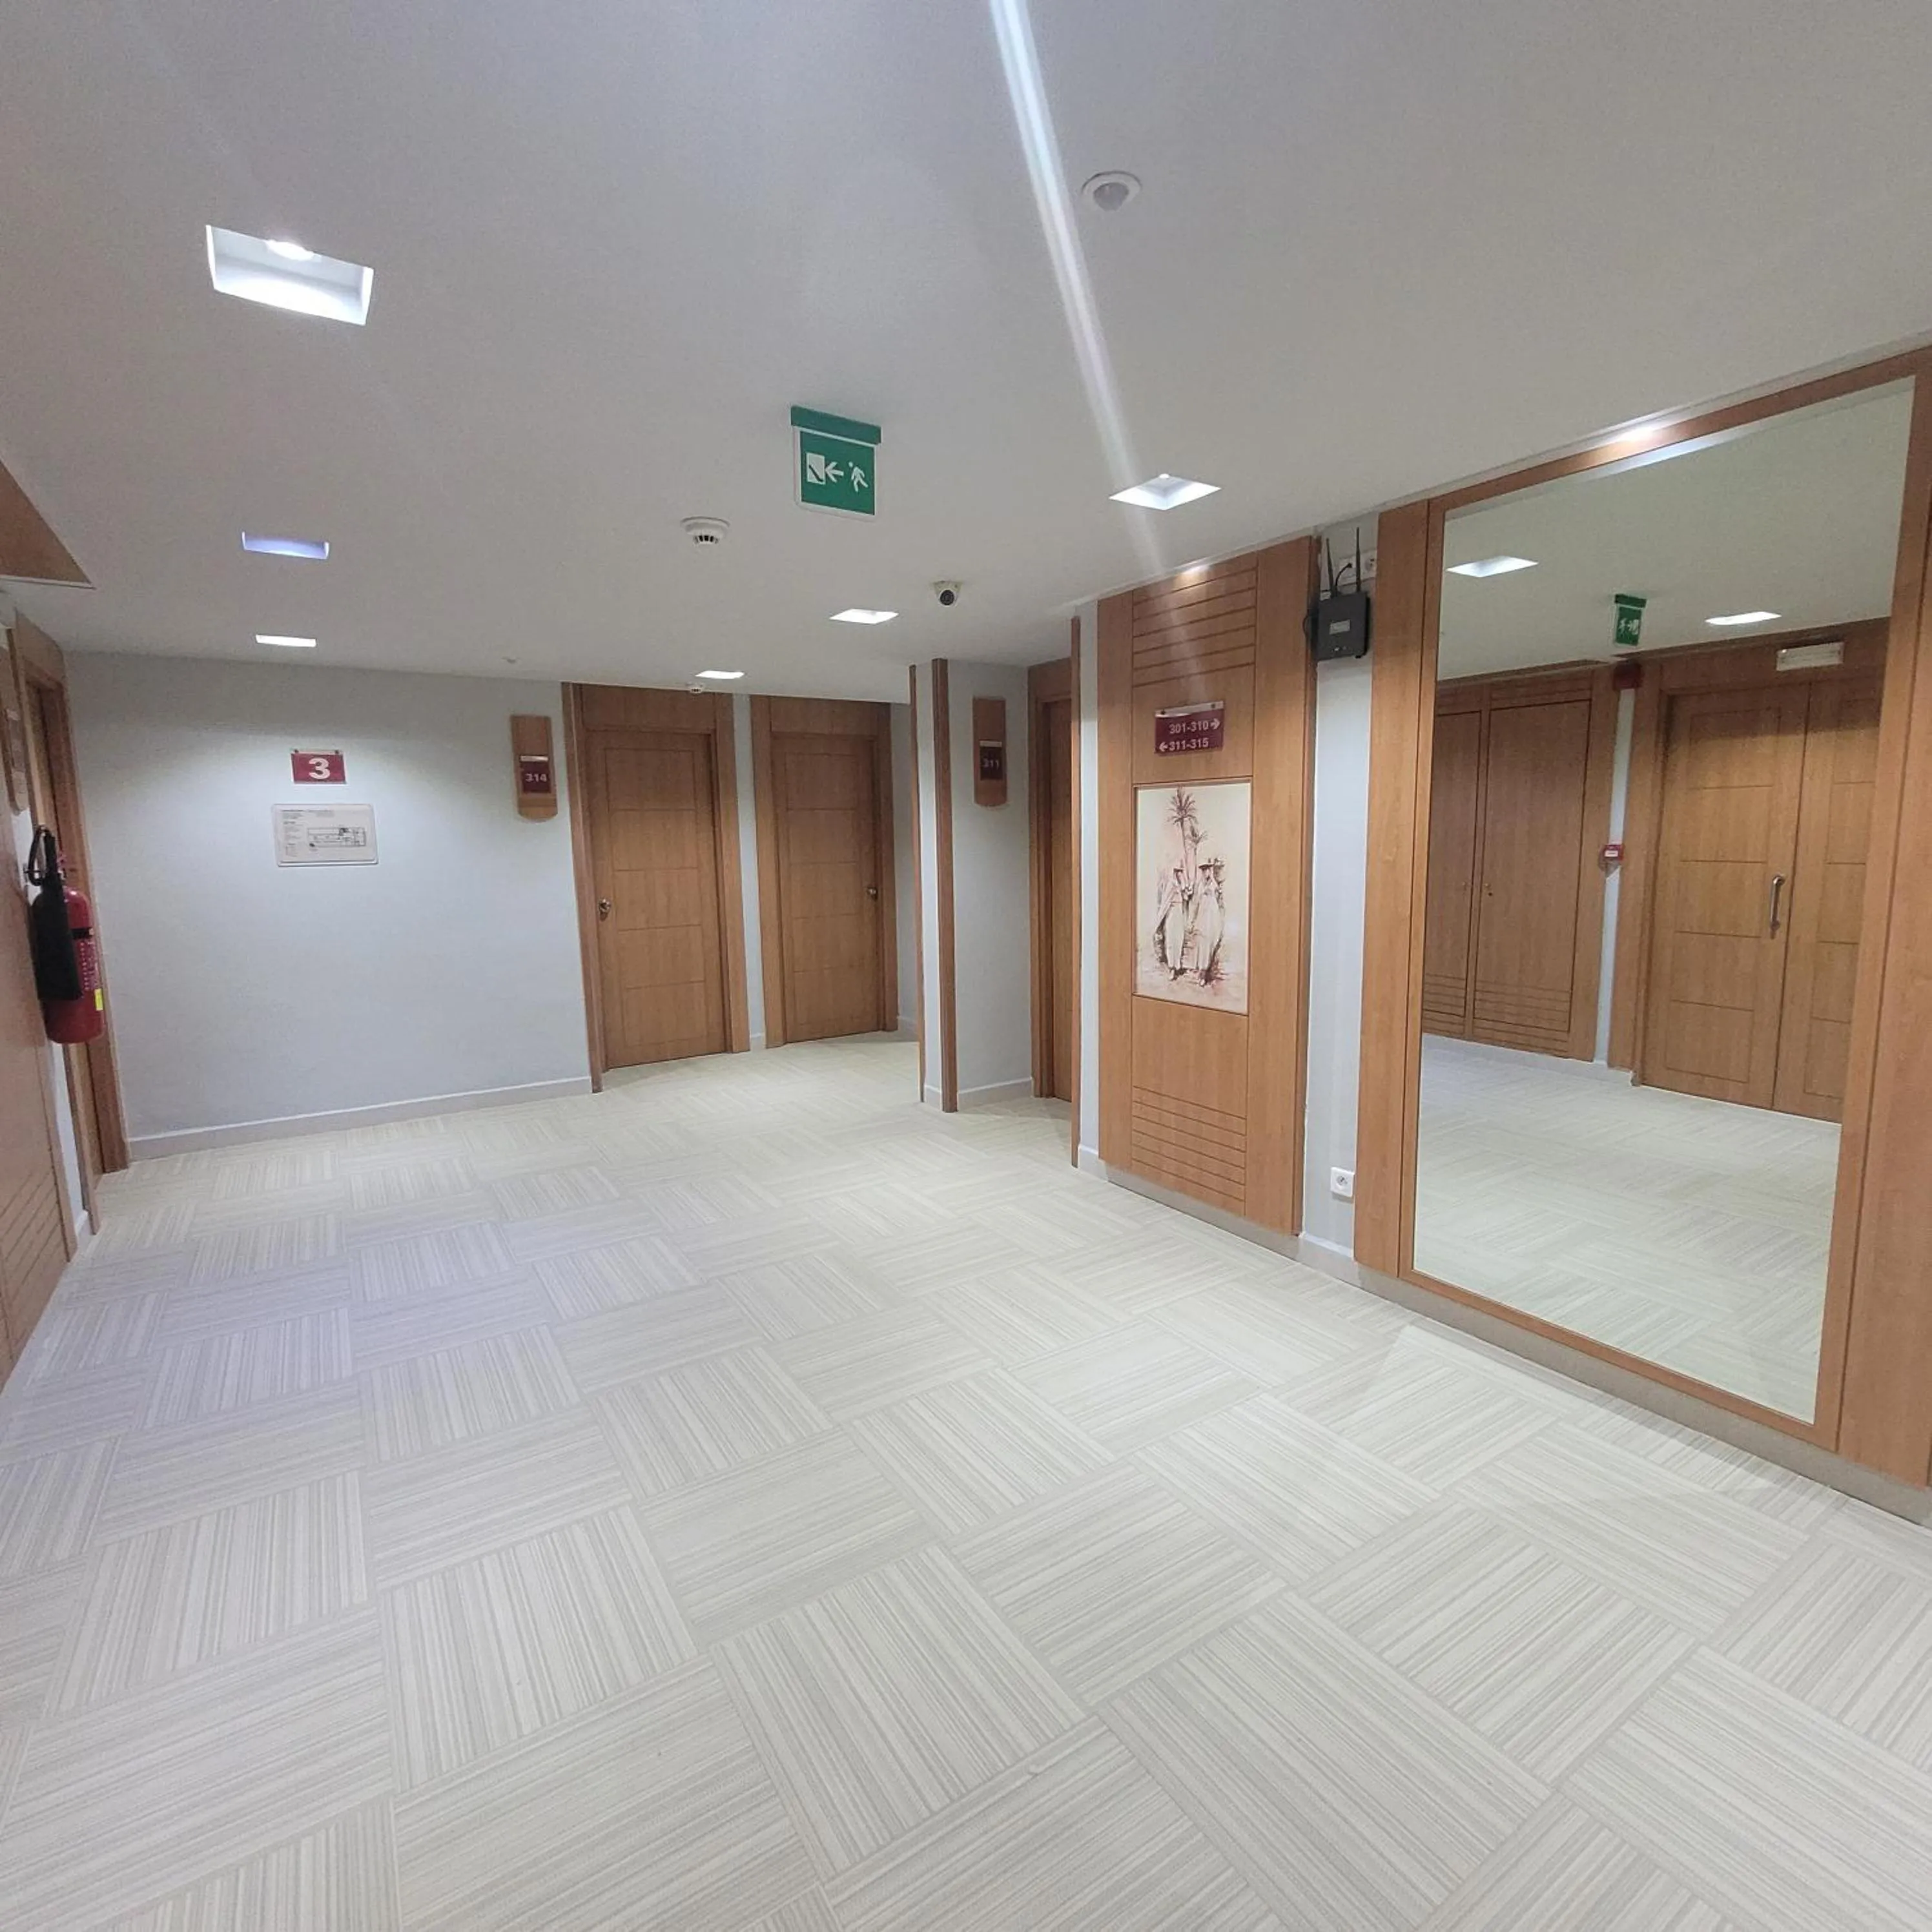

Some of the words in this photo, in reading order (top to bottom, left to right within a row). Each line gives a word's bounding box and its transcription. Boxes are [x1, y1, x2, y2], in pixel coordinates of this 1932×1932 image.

[1169, 721, 1209, 734] 301-310
[1169, 737, 1209, 751] 311-315
[308, 757, 331, 780] 3
[525, 773, 547, 782] 314
